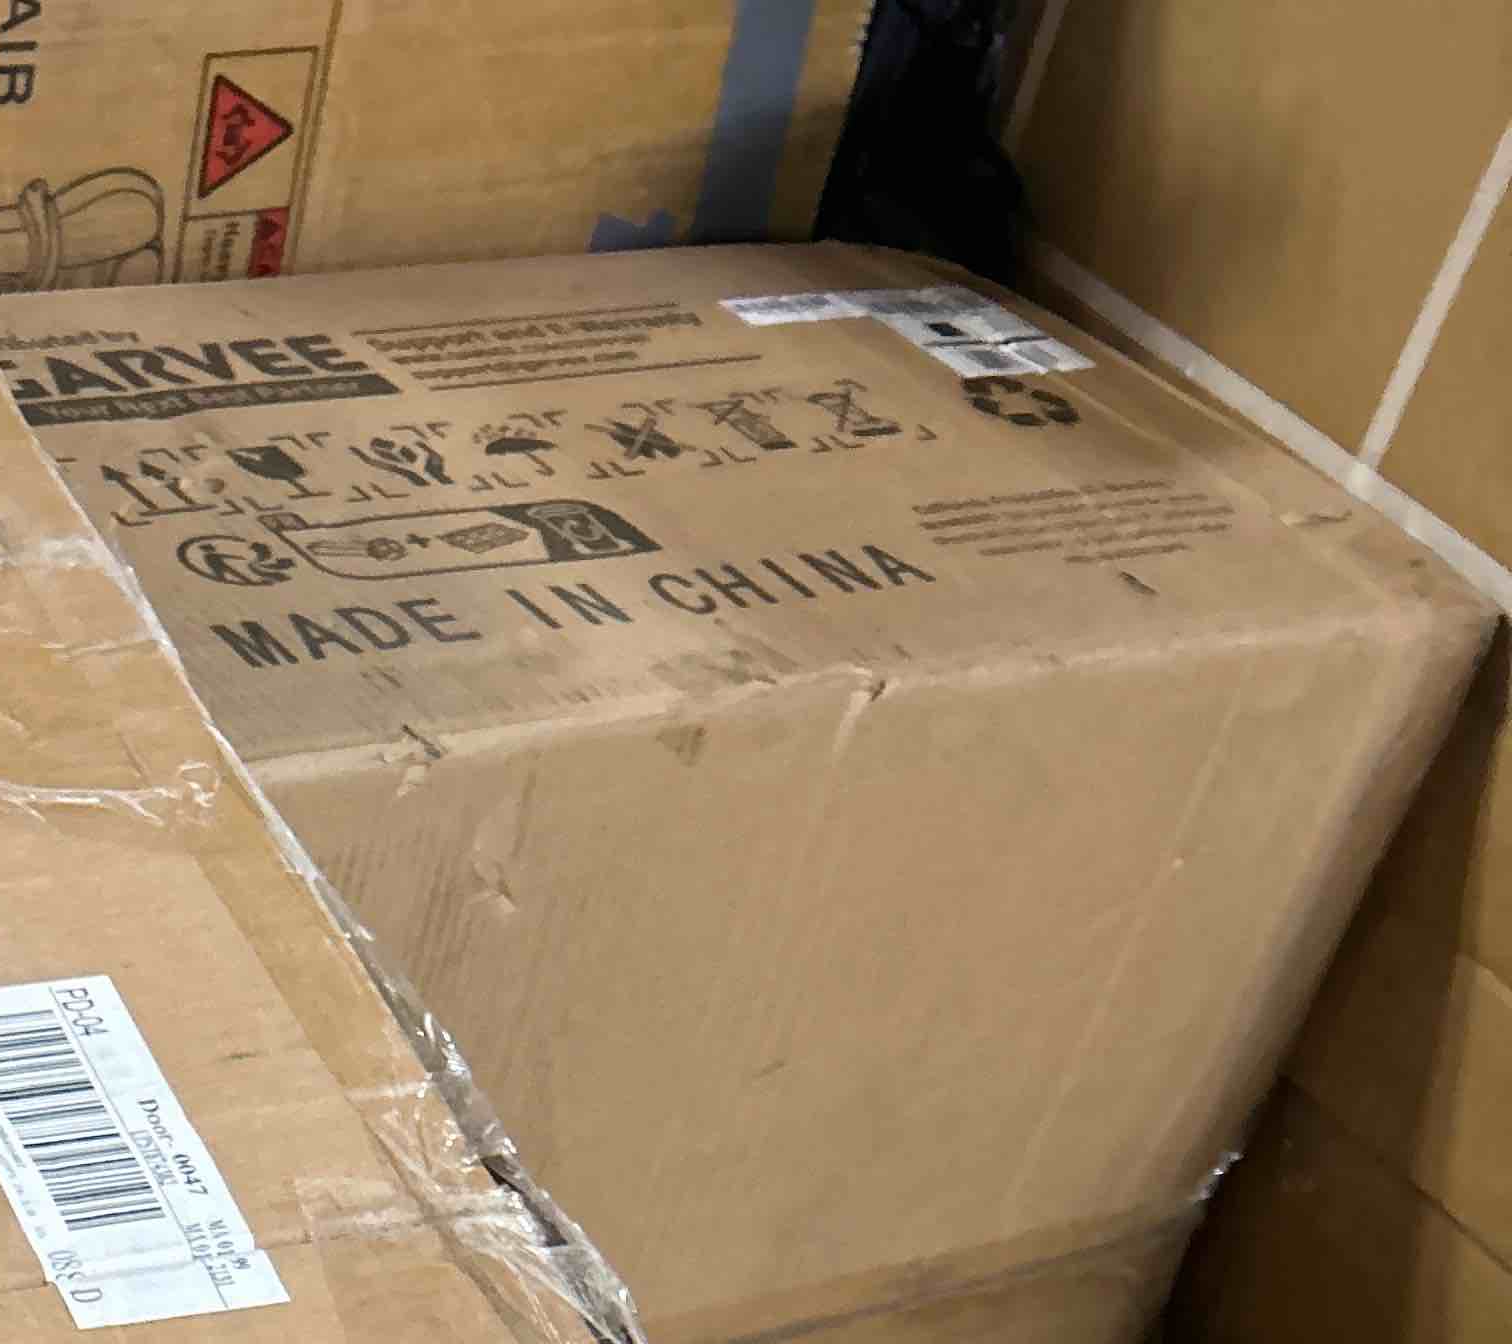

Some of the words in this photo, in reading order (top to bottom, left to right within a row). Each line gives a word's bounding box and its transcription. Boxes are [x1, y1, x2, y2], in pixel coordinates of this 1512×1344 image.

[209, 598, 482, 669] MADE
[504, 581, 637, 630] IN
[647, 543, 937, 616] CHINA
[54, 987, 108, 1037] PD-04
